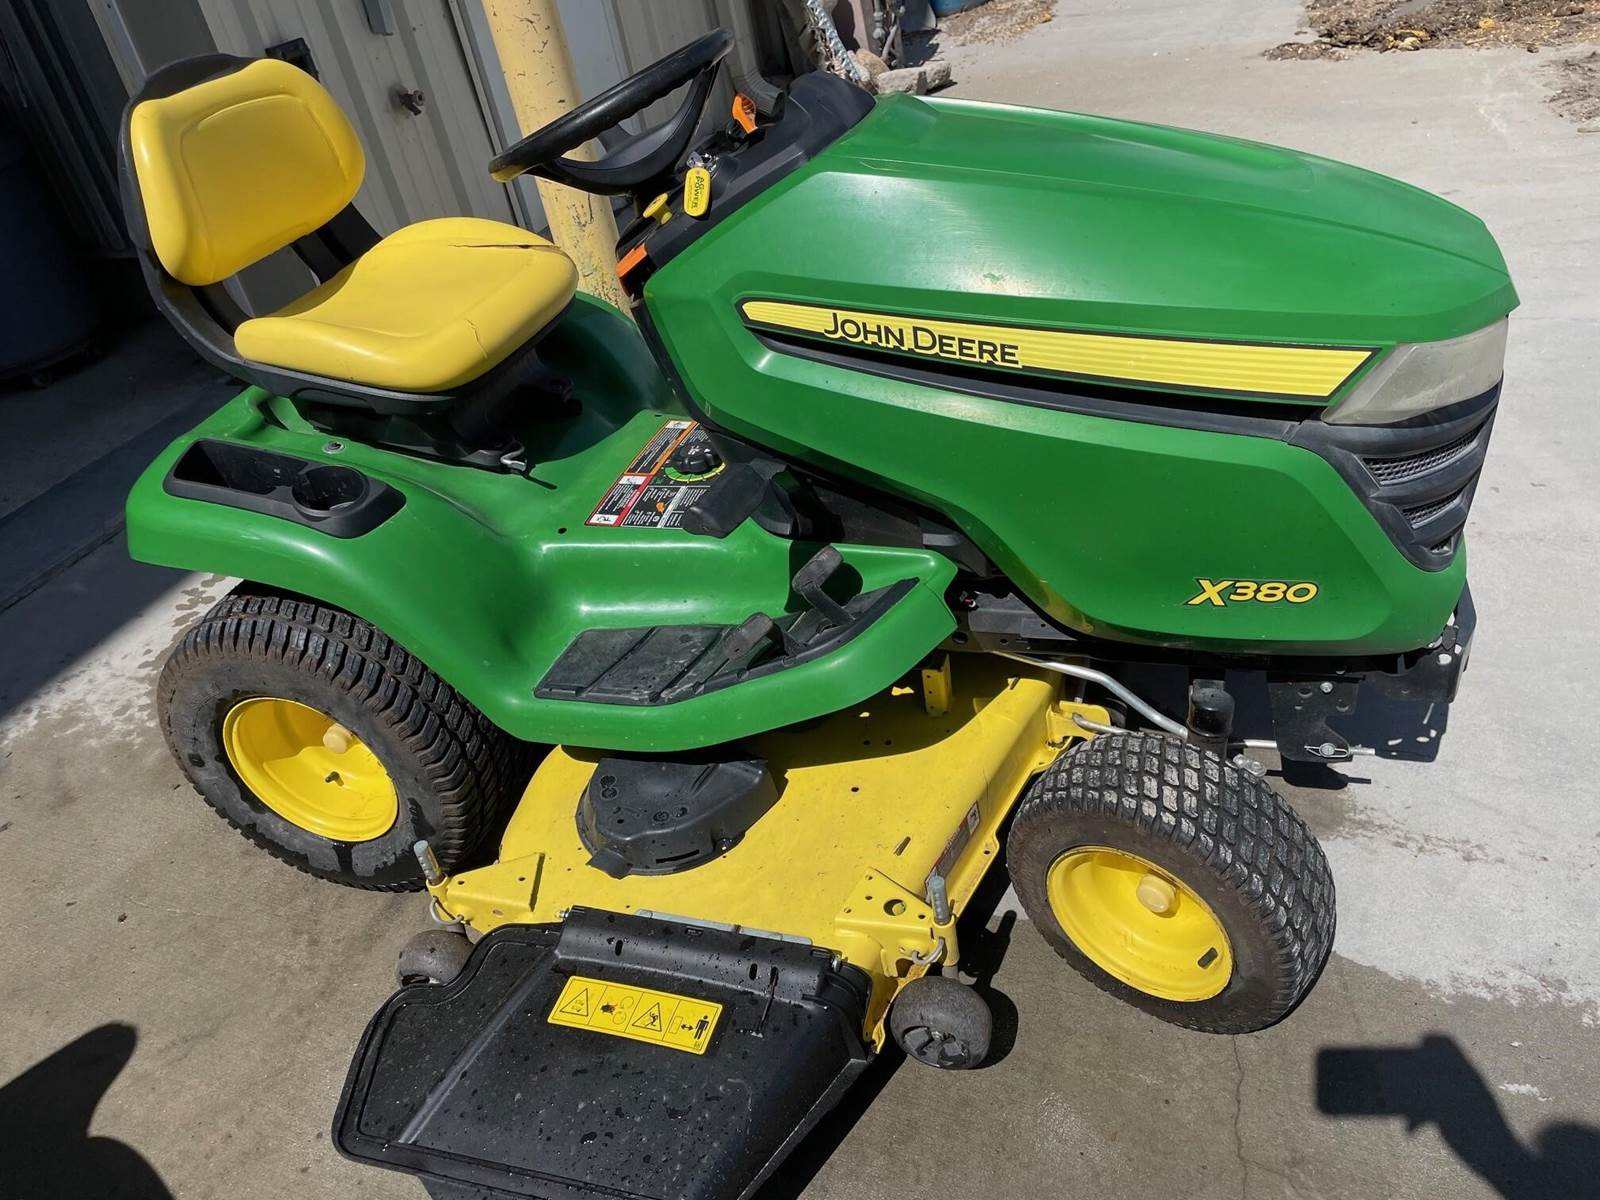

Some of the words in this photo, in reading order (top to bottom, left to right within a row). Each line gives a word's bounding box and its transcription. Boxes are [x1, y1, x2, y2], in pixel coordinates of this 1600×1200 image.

[823, 312, 905, 348] JOHN
[912, 325, 1019, 366] DEERE
[1186, 578, 1319, 607] X380
